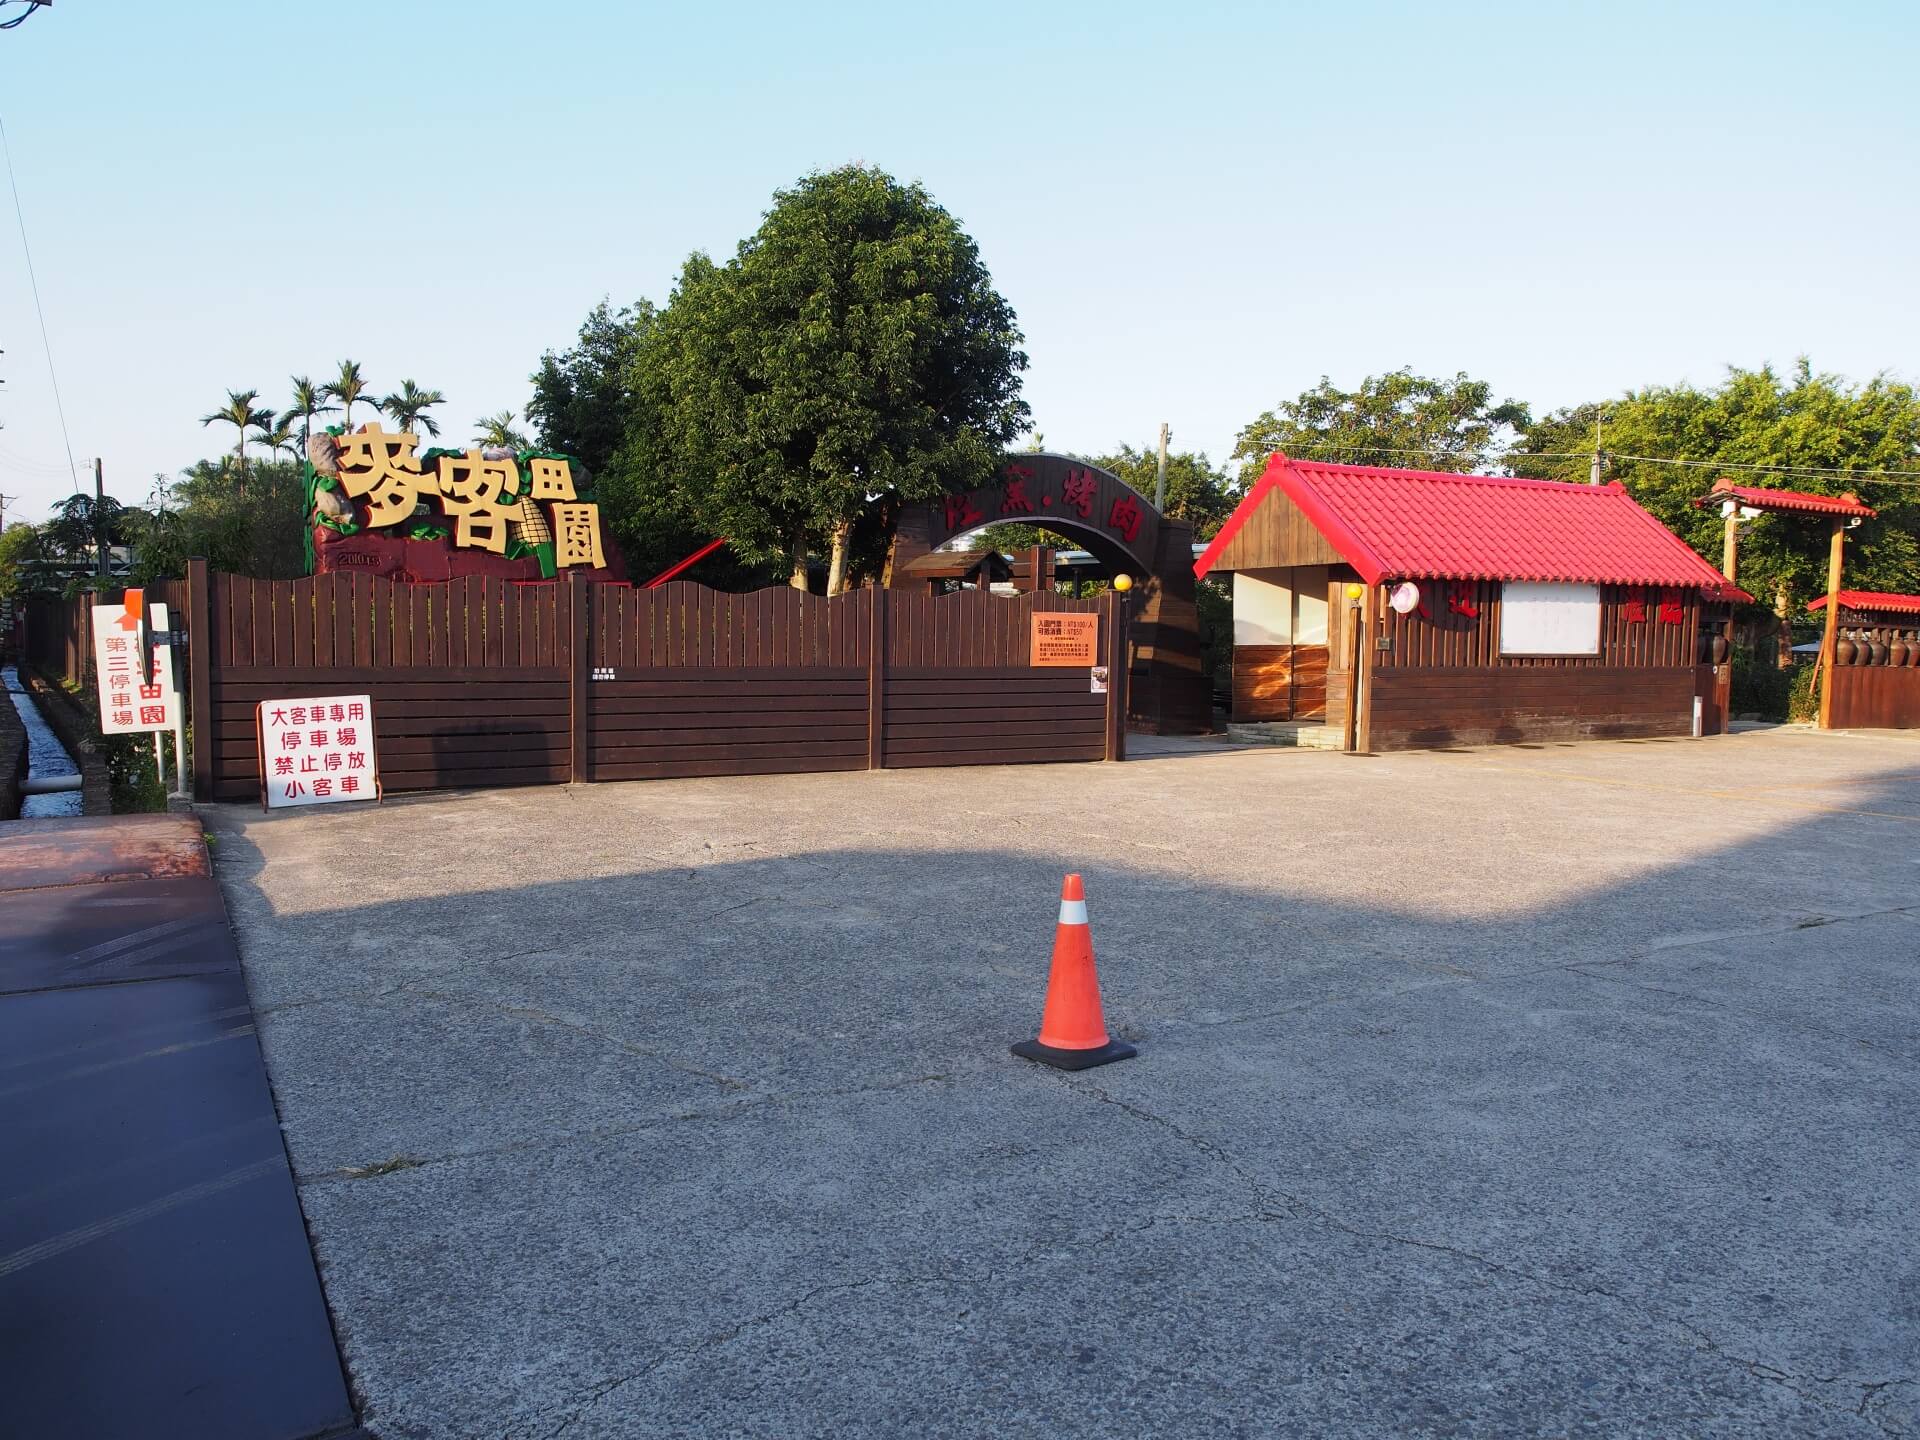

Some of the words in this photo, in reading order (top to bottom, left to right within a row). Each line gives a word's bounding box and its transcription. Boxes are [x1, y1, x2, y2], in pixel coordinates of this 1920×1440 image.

[106, 637, 134, 726] 第三停車場
[270, 703, 364, 727] 大客車專用
[281, 727, 357, 750] 停車場
[274, 751, 366, 775] 禁止停放
[285, 776, 360, 799] 小客車
